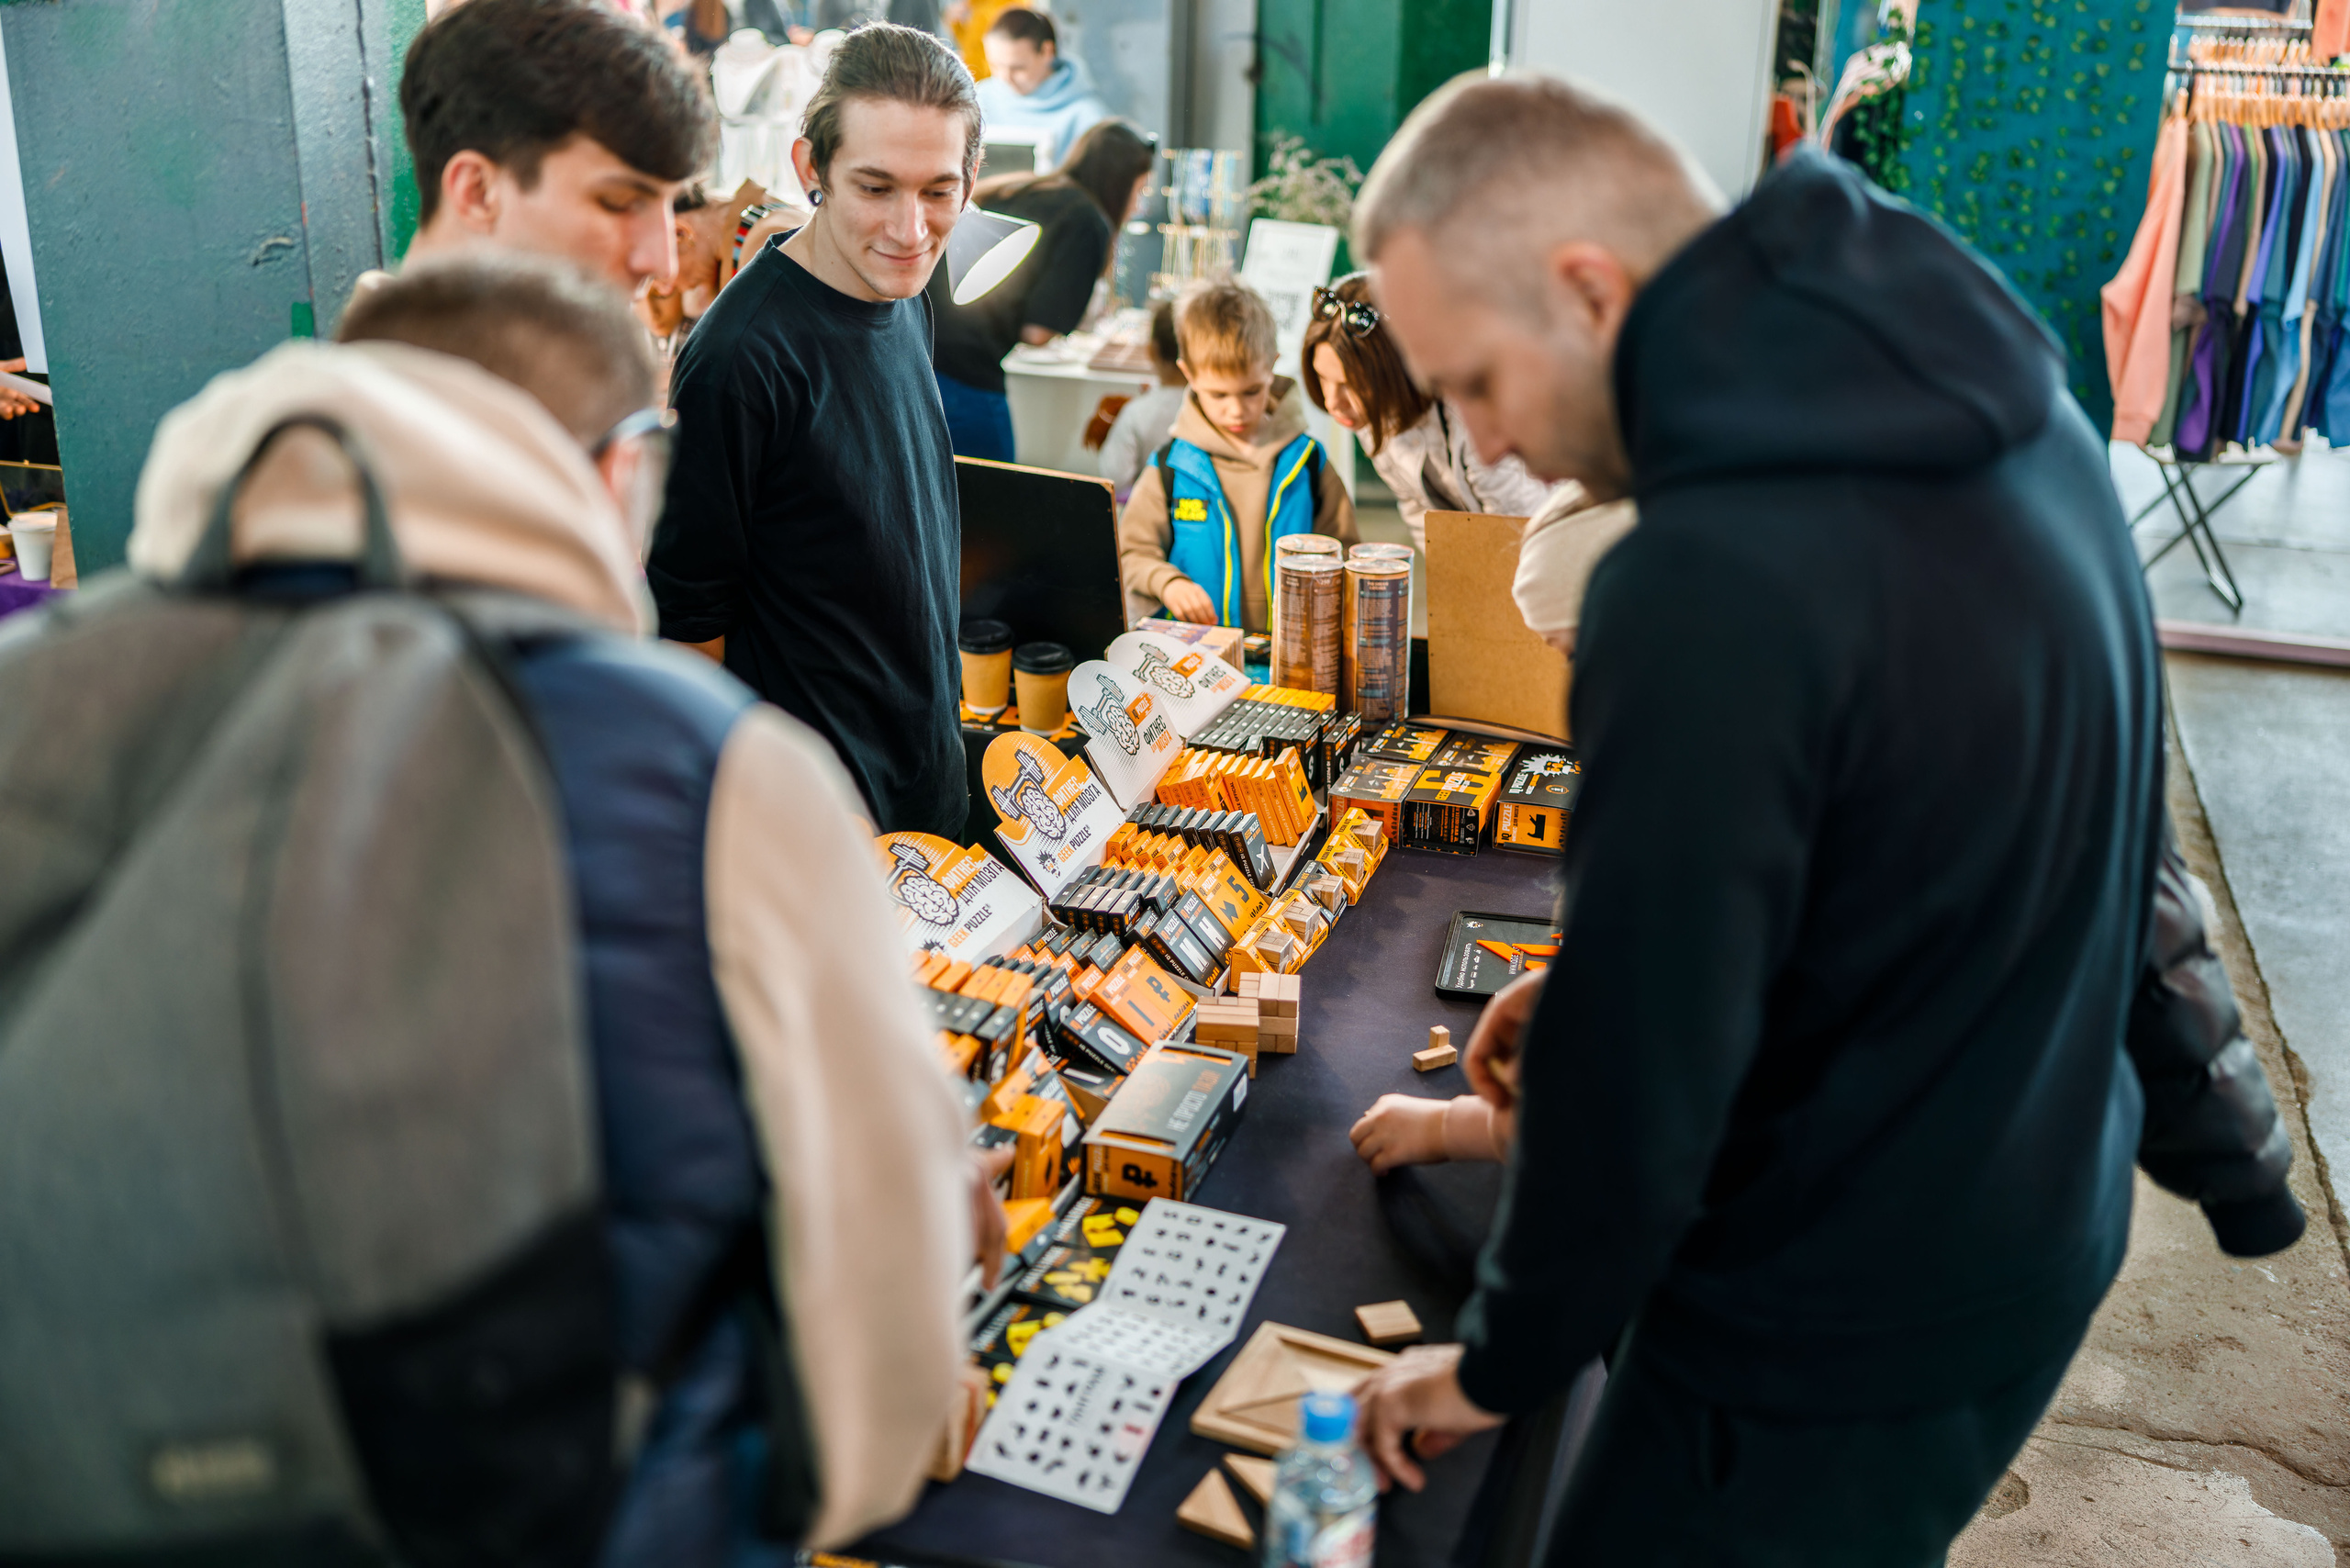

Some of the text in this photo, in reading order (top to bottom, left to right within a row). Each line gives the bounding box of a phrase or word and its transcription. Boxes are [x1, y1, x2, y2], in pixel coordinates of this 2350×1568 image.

[1198, 665, 1226, 689] ФИТНЕС
[1135, 697, 1150, 716] PUZZLE
[1143, 714, 1167, 745] ФИТНЕС
[1155, 729, 1173, 754] МОЗГА
[1052, 775, 1081, 806] ФИТНЕС
[1441, 771, 1468, 791] PUZZLE
[1511, 772, 1528, 790] PUZZLE
[1063, 783, 1102, 825] ДЛЯ МОЗГА
[1285, 790, 1294, 808] PUZZLE
[1292, 807, 1303, 828] OFFICIAL
[1263, 802, 1271, 820] PUZZLE
[1269, 819, 1279, 840] OFFICIAL
[1278, 804, 1286, 822] PUZZLE
[1284, 822, 1293, 842] OFFICIAL
[1501, 804, 1513, 841] IQ PUZZLE
[1057, 843, 1075, 863] GEEK
[1172, 842, 1185, 857] PUZZLE
[1213, 852, 1226, 868] PUZZLE
[941, 855, 977, 890] ФИТНЕС
[1242, 860, 1252, 878] PUZZLE
[956, 859, 1005, 906] ДЛЯ МОЗГА
[1179, 870, 1196, 893] IQ PUZZLE
[1198, 873, 1217, 897] IQ PUZZLE
[1180, 894, 1200, 920] IQ PUZZLE
[1041, 927, 1058, 944] PUZZLE
[1159, 930, 1170, 940] IQ
[1163, 915, 1181, 936] PUZZLE
[1252, 920, 1267, 933] PUZZLE
[947, 927, 970, 948] GEEK
[1127, 950, 1144, 967] PUZZLE
[1169, 959, 1187, 977] PUZZLE
[1454, 942, 1472, 989] Удобно использовать
[1049, 974, 1069, 998] PUZZLE
[1078, 986, 1087, 995] IQ
[1081, 970, 1102, 991] PUZZLE
[1105, 973, 1126, 995] PUZZLE
[1102, 990, 1112, 999] IQ
[1025, 999, 1044, 1023] PUZZLE
[1074, 1002, 1098, 1025] PUZZLE
[1172, 1090, 1208, 1122] ПРОСТО
